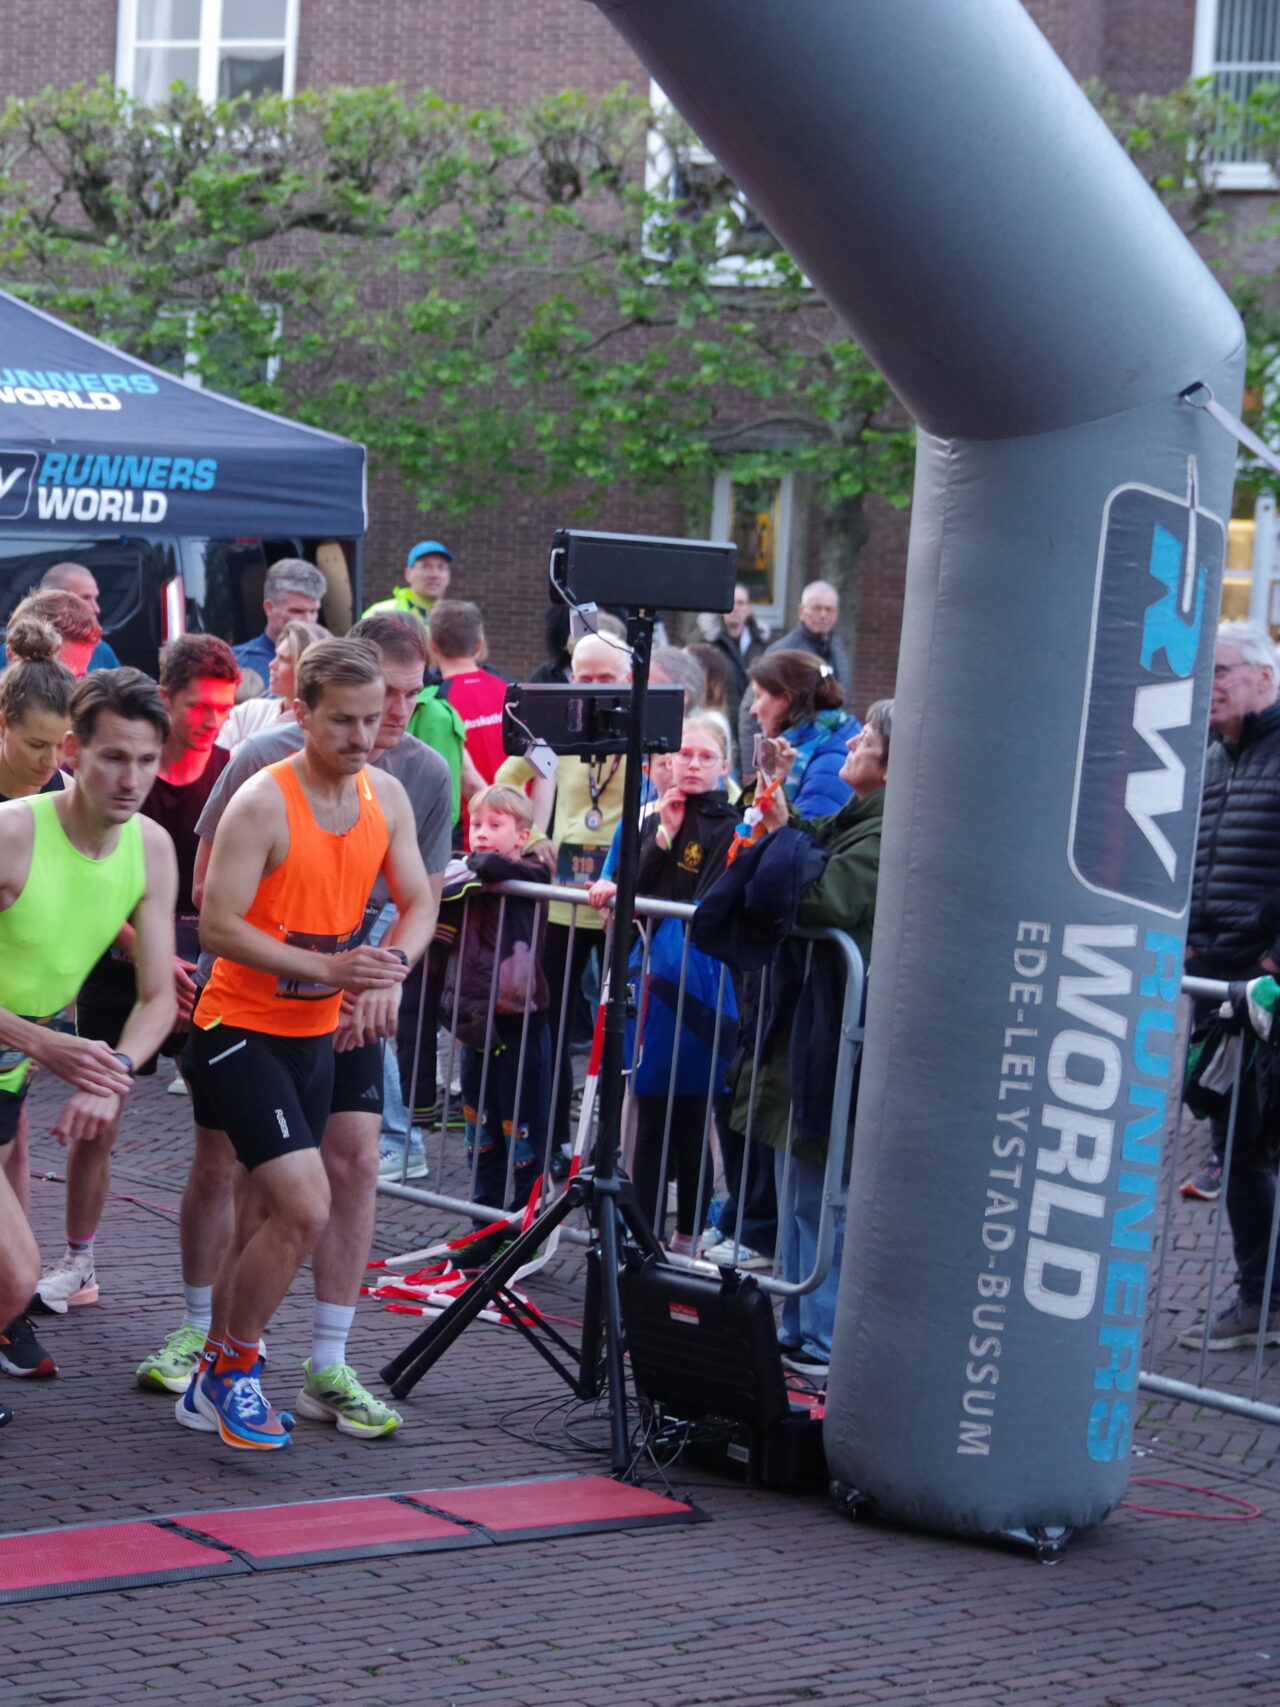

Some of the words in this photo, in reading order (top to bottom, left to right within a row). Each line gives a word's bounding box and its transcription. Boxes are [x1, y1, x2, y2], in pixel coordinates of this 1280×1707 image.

[37, 453, 218, 491] RUNNERS
[37, 488, 168, 523] WORLD
[1125, 520, 1207, 883] RW
[956, 920, 1051, 1456] EDE-LELYSTAD-BUSSUM
[1023, 923, 1138, 1321] WORLD
[1085, 928, 1183, 1464] RUNNERS
